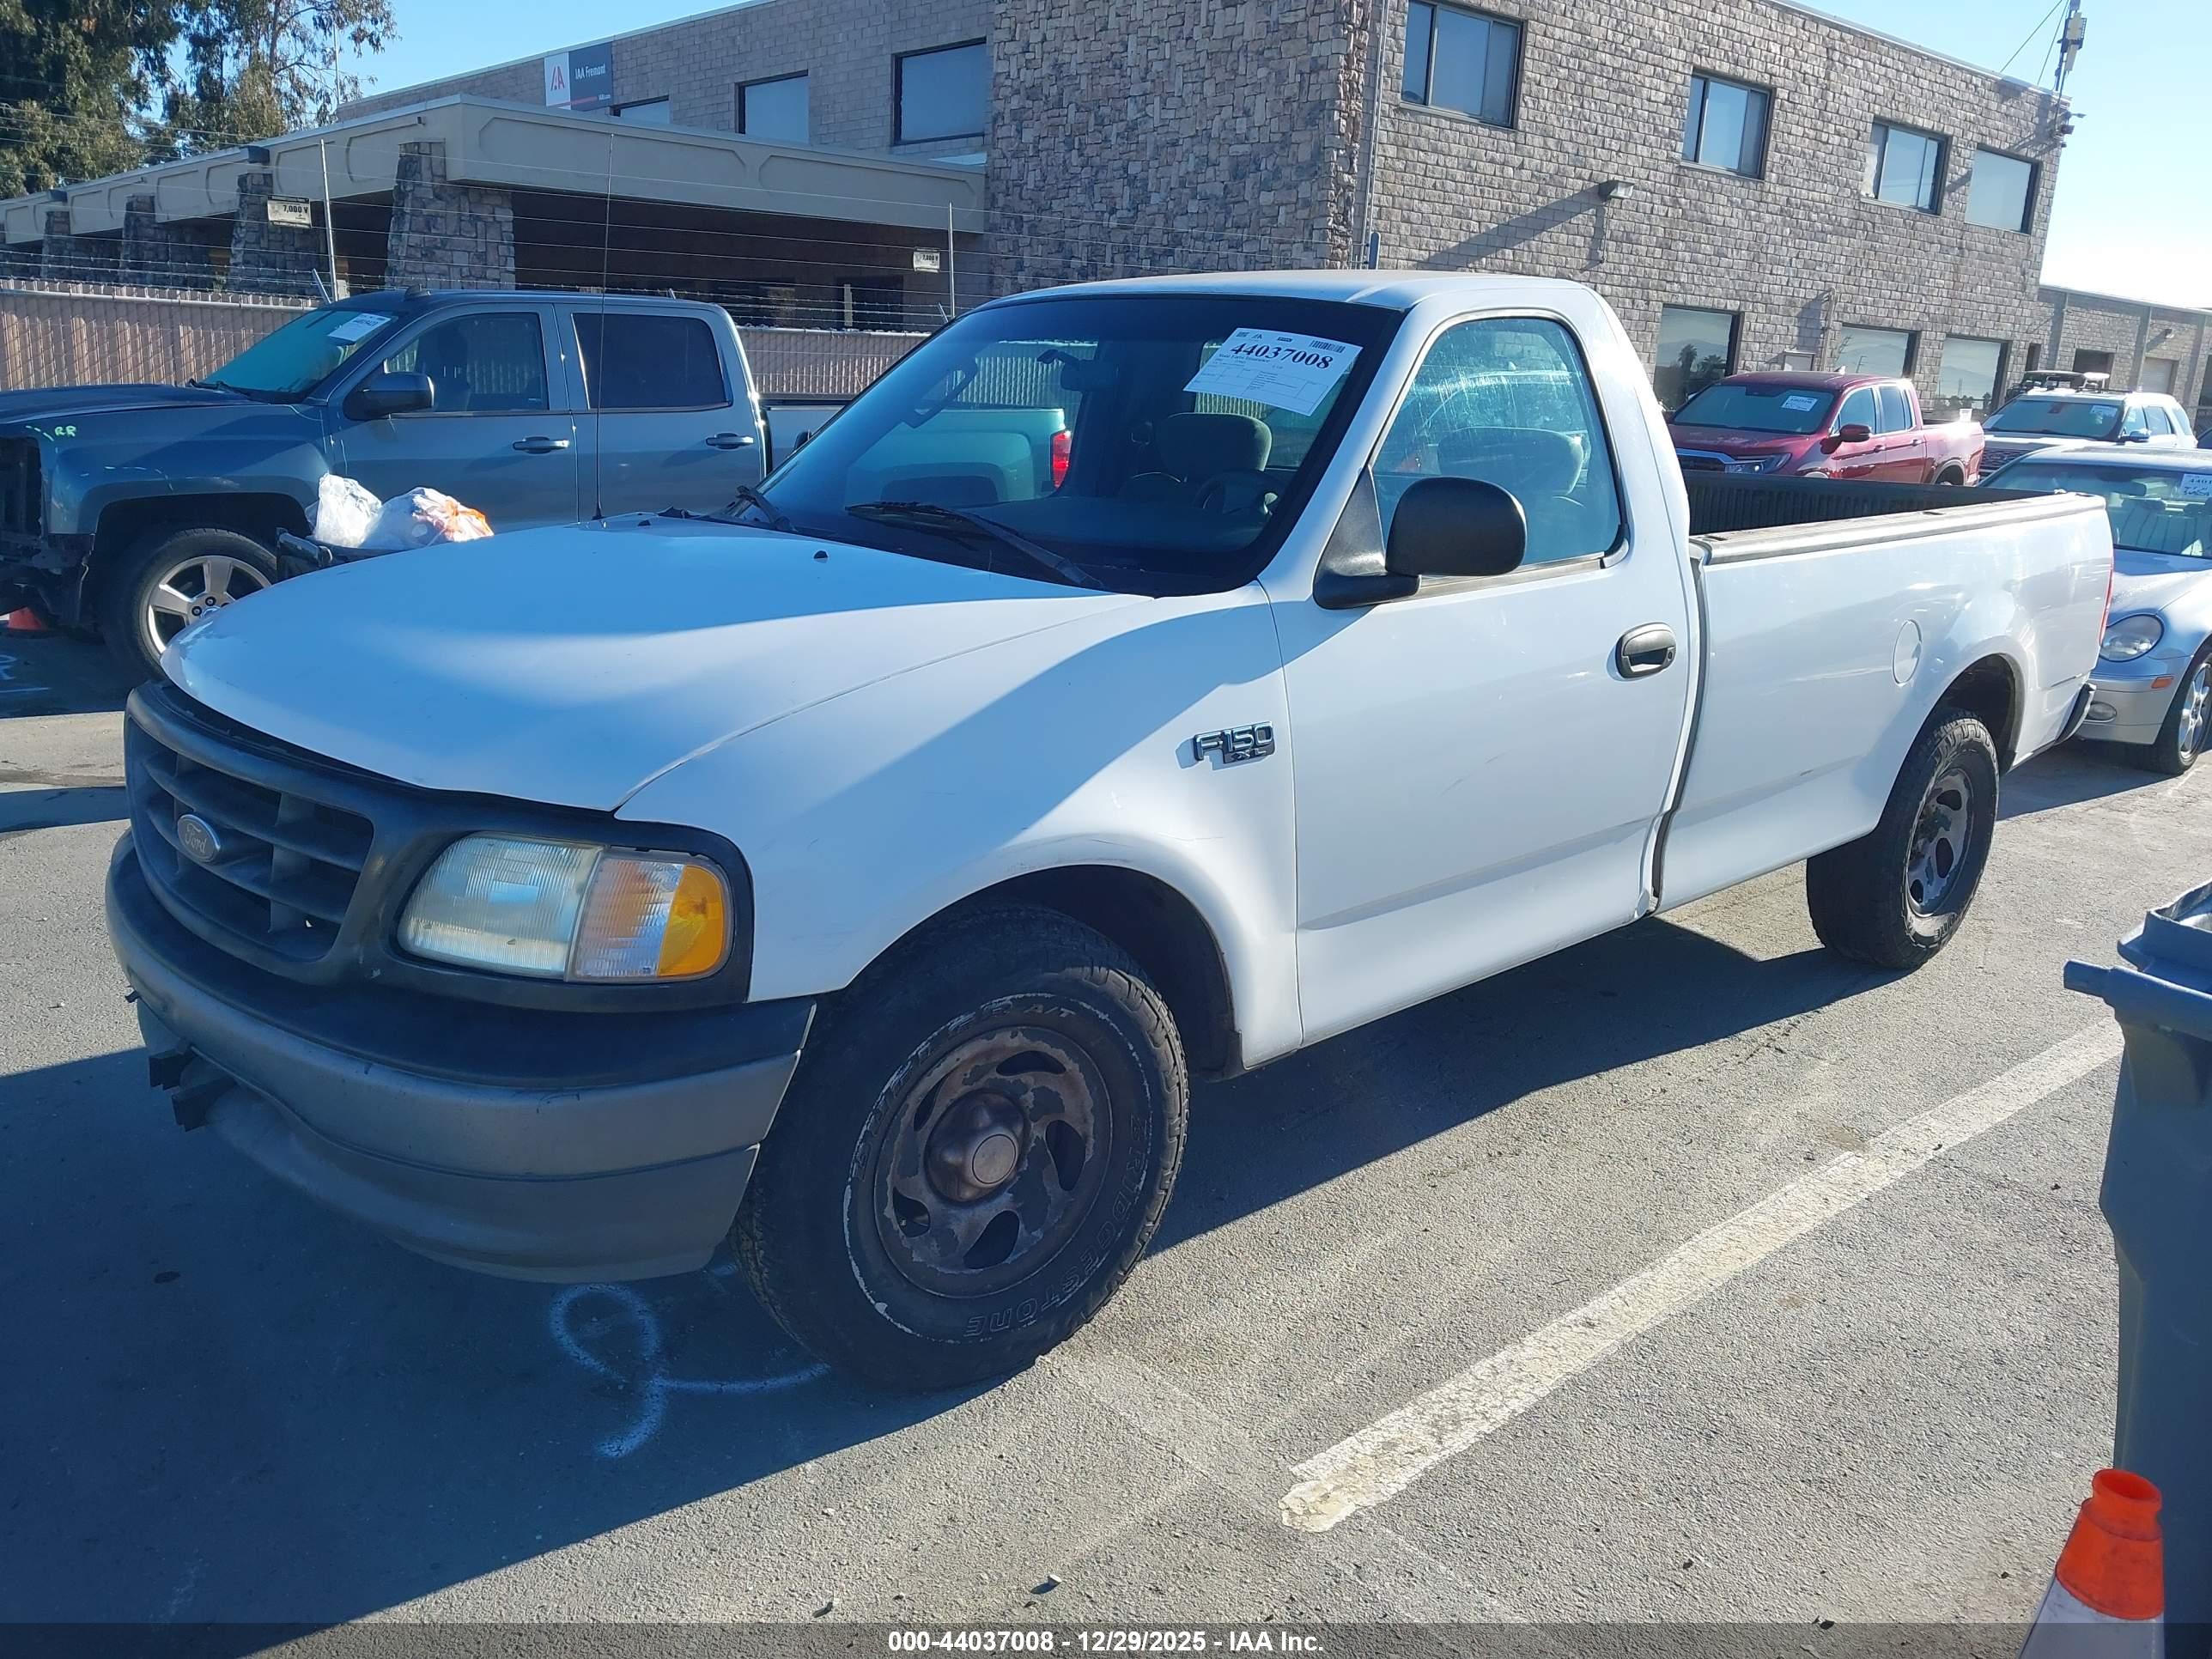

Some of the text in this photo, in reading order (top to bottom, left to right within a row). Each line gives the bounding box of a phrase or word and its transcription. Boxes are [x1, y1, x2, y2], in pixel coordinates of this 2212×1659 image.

[574, 64, 606, 80] IAA Fremont
[283, 204, 302, 214] 7,000
[1231, 342, 1334, 370] 44037008
[185, 823, 208, 854] Ford
